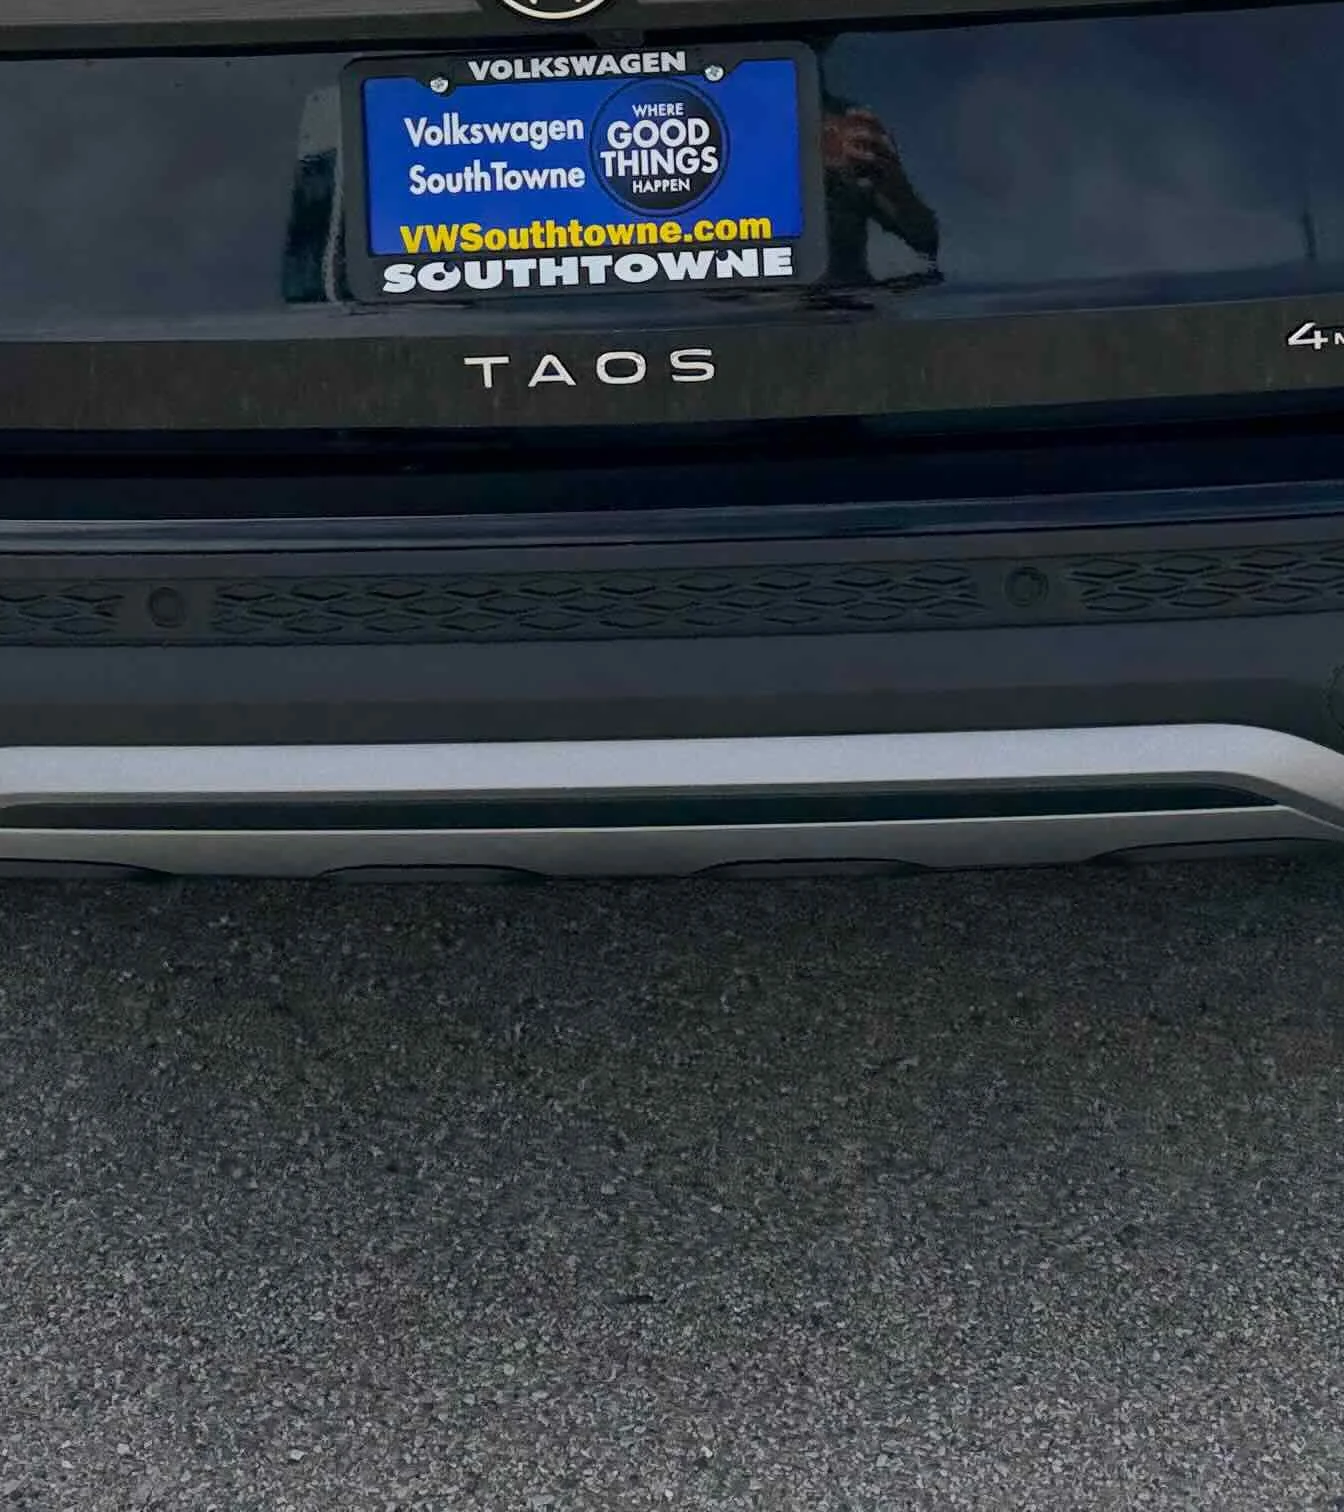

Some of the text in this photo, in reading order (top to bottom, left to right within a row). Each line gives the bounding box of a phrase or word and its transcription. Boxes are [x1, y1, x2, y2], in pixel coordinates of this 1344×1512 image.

[468, 51, 687, 81] VOLKSWAGEN
[632, 102, 685, 118] WHERE
[403, 112, 585, 150] Volkswagen
[606, 118, 711, 149] GOOD
[408, 159, 586, 196] SouthTowne
[599, 146, 719, 178] THINGS
[631, 177, 691, 194] HAPPEN
[399, 216, 773, 254] VWSouthtowne.com
[382, 246, 794, 294] SOUTHTOWNE
[463, 348, 717, 389] TAOS
